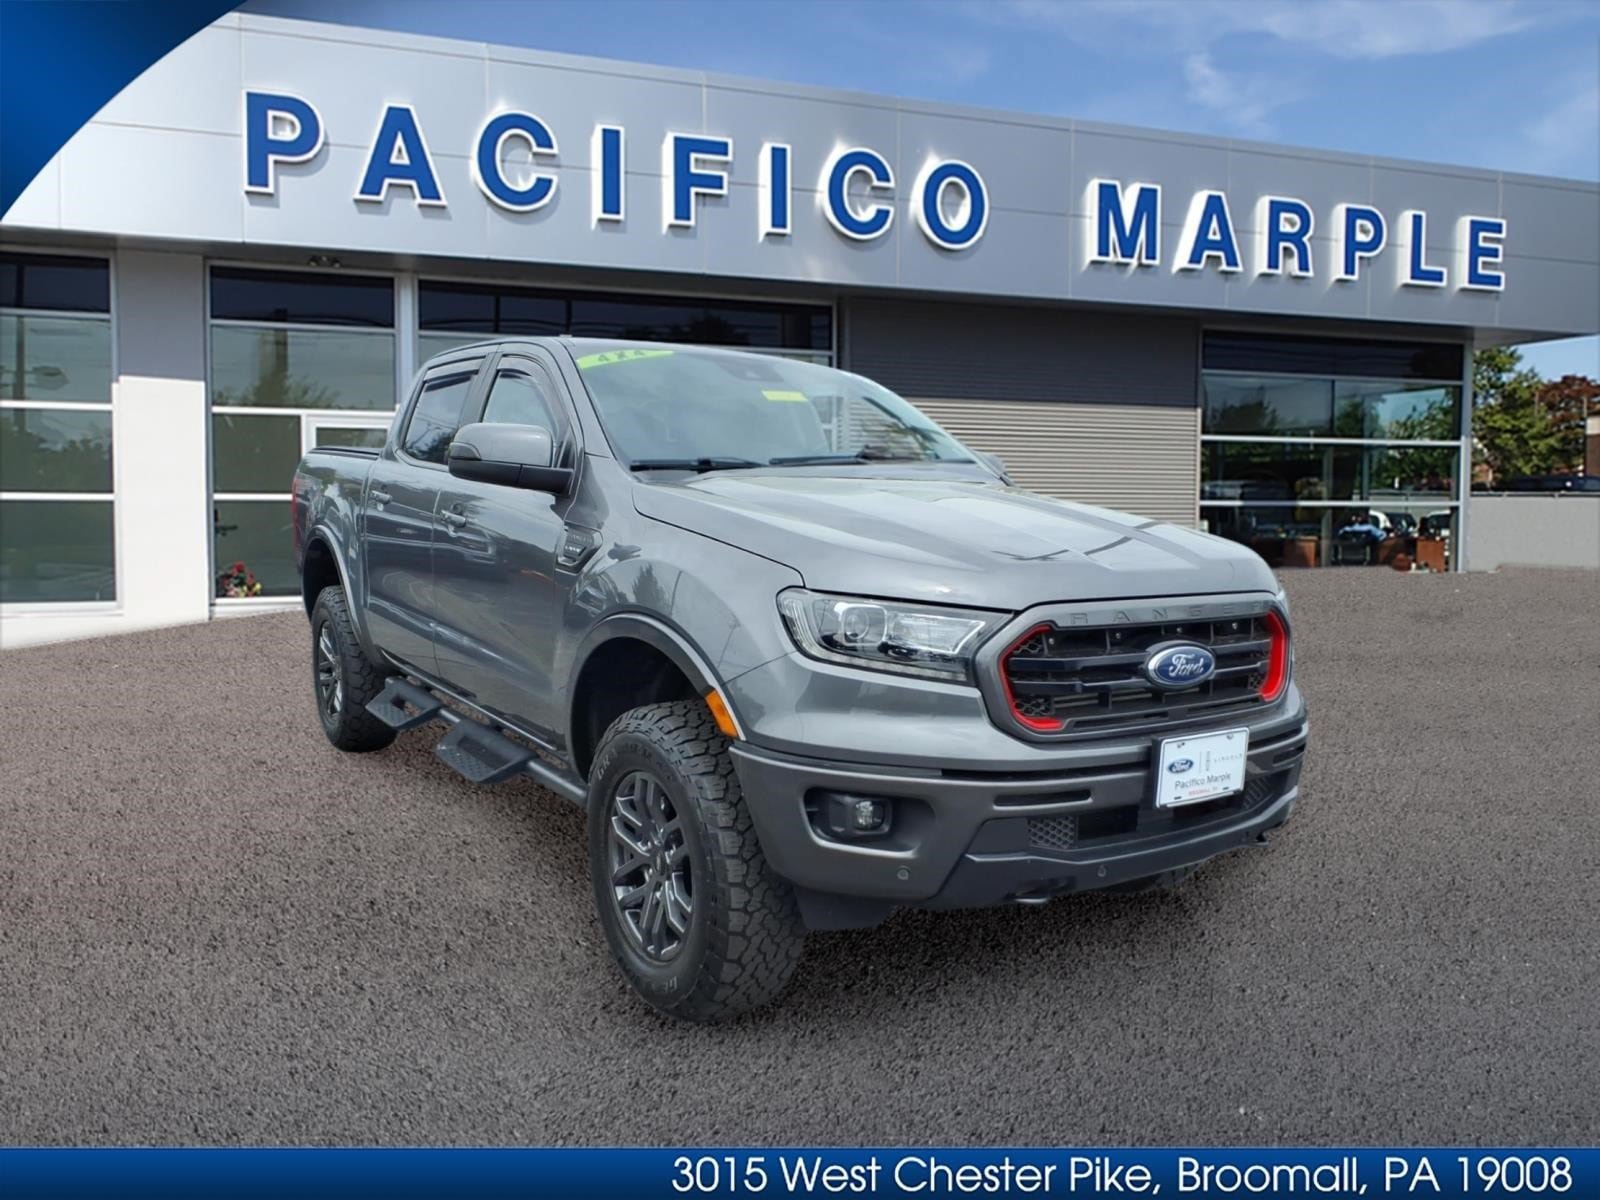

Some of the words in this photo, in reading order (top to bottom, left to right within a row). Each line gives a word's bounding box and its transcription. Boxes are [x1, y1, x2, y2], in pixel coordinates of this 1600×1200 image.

[244, 90, 989, 250] PACIFICO
[1088, 178, 1507, 291] MARPLE
[1070, 601, 1268, 625] RANGER
[1167, 653, 1205, 677] Ford
[1174, 777, 1205, 790] Pacifico
